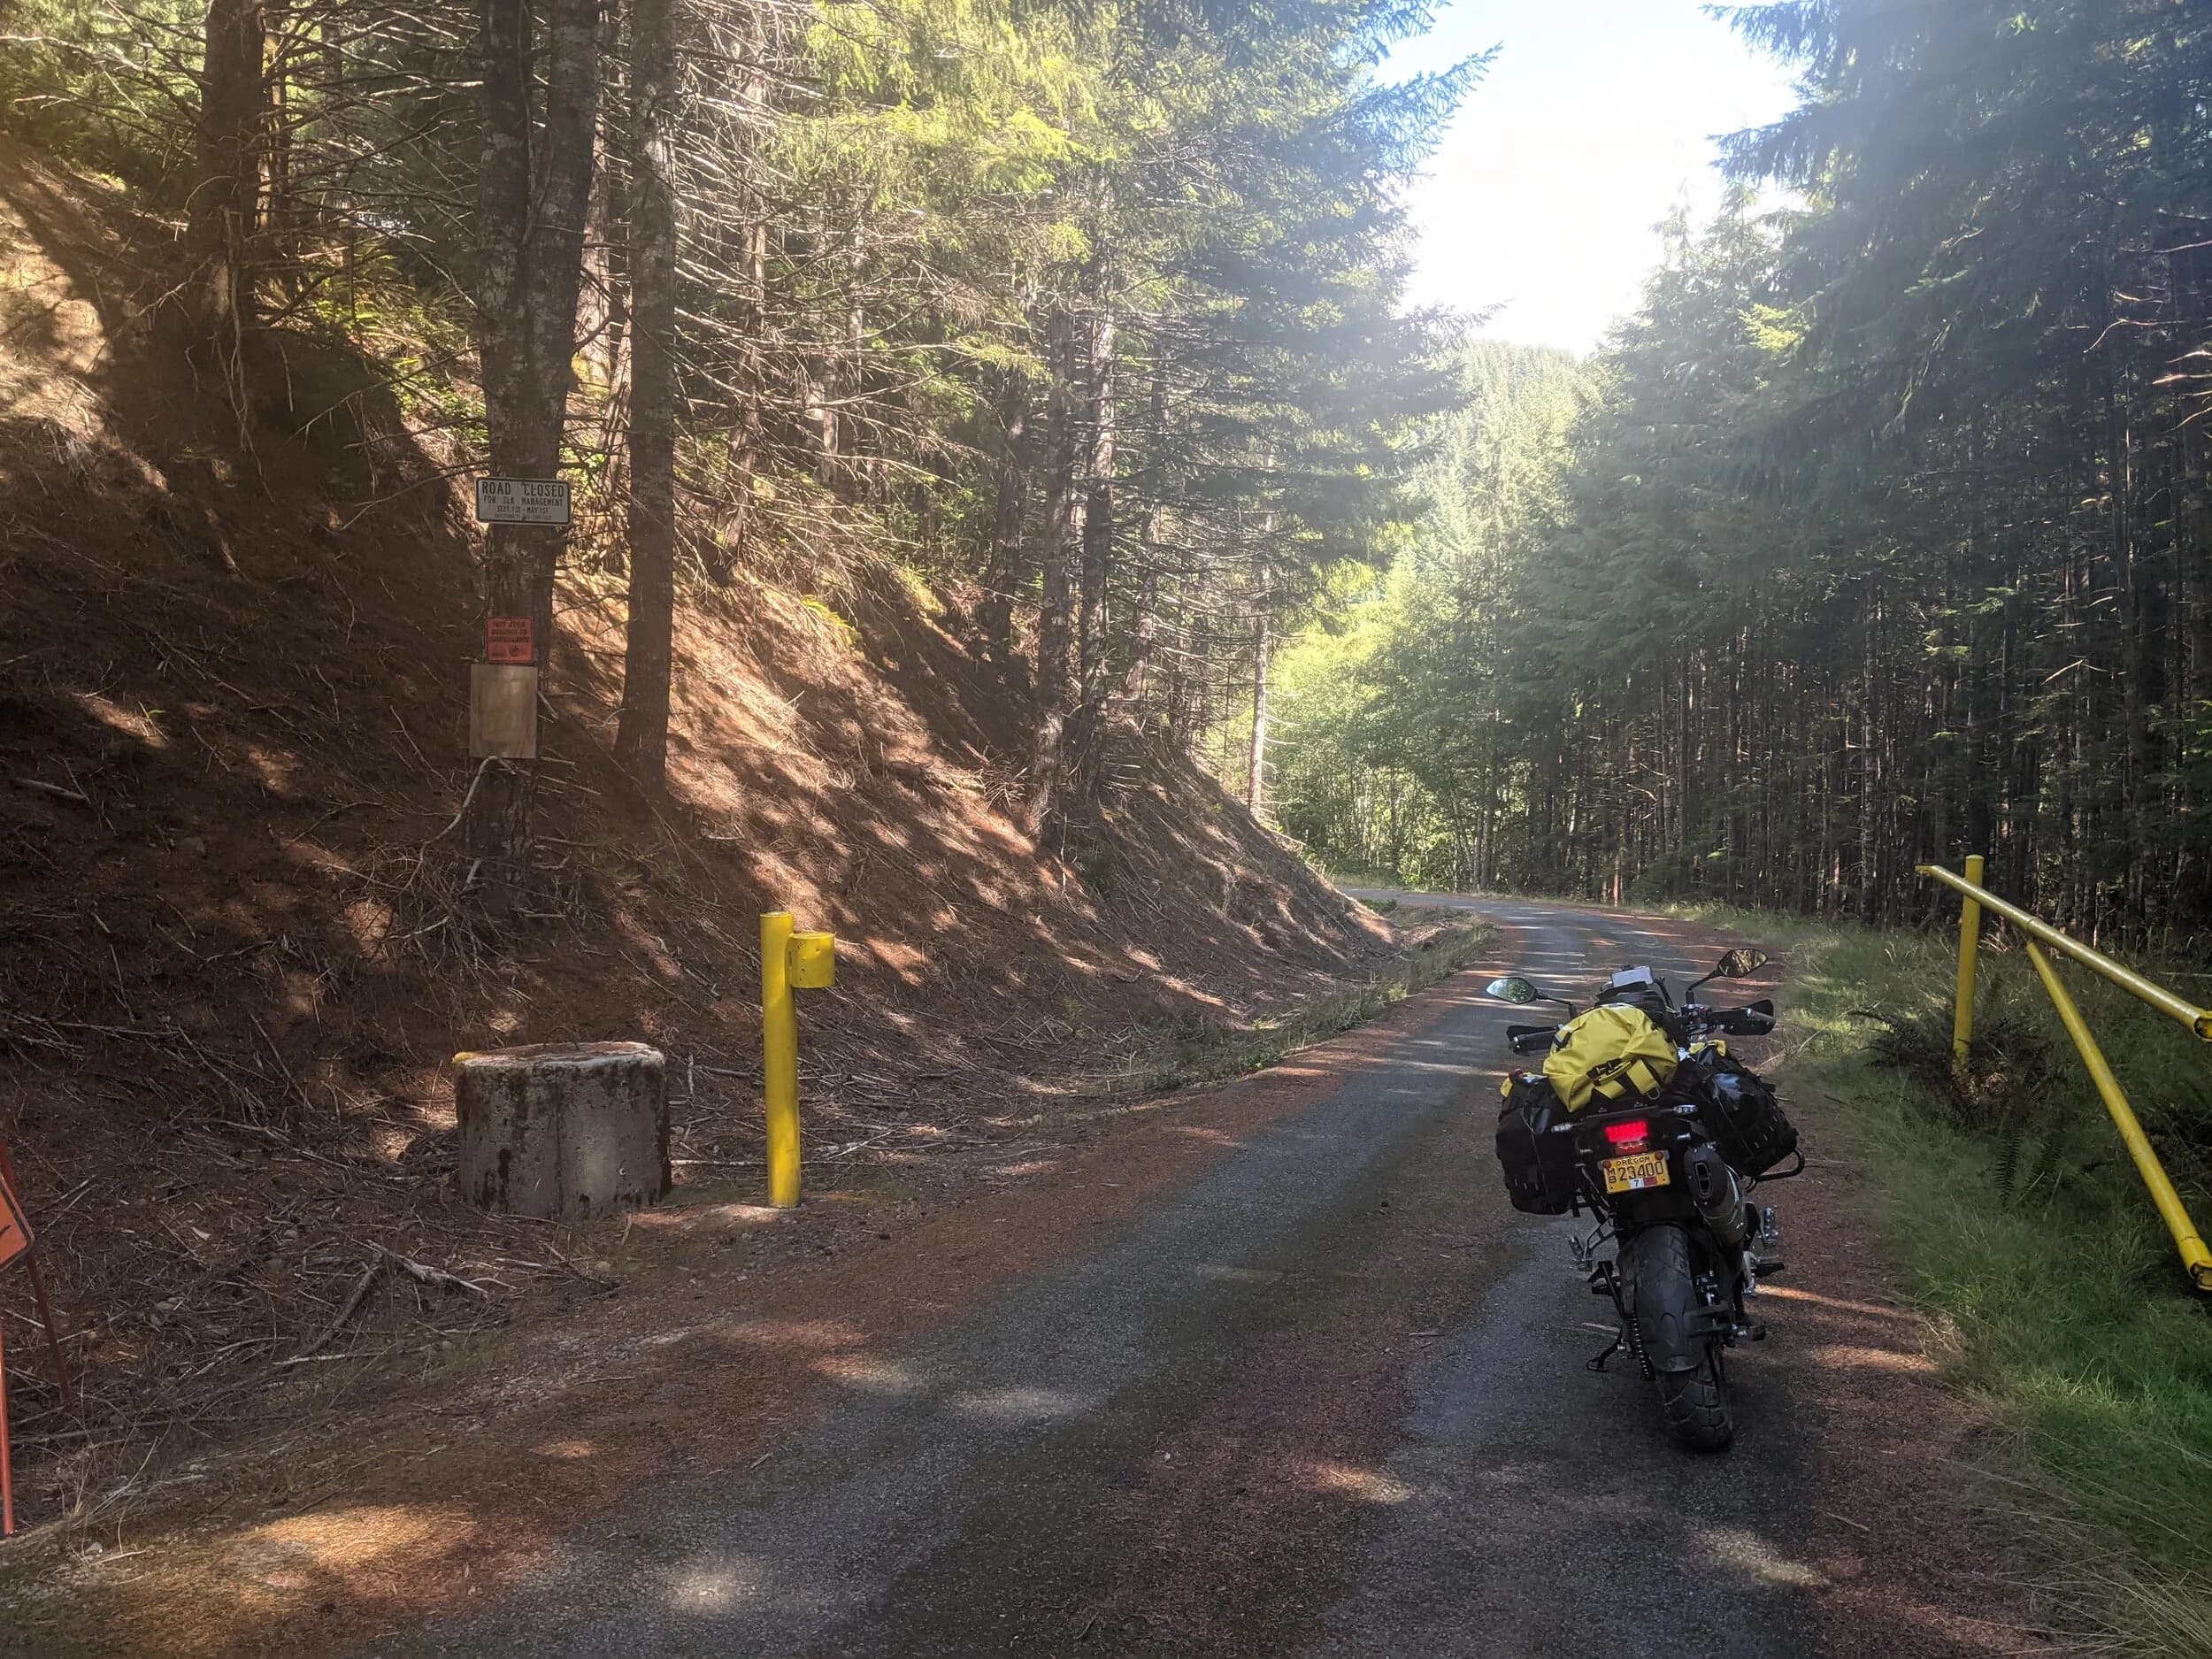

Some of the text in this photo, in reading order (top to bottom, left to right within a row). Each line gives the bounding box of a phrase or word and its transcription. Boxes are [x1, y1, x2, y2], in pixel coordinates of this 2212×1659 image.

[482, 481, 565, 497] ROAD CLOSED
[522, 498, 563, 507] MANAGEMENT
[1616, 1156, 1650, 1166] OREGON
[1617, 1161, 1663, 1181] 23400
